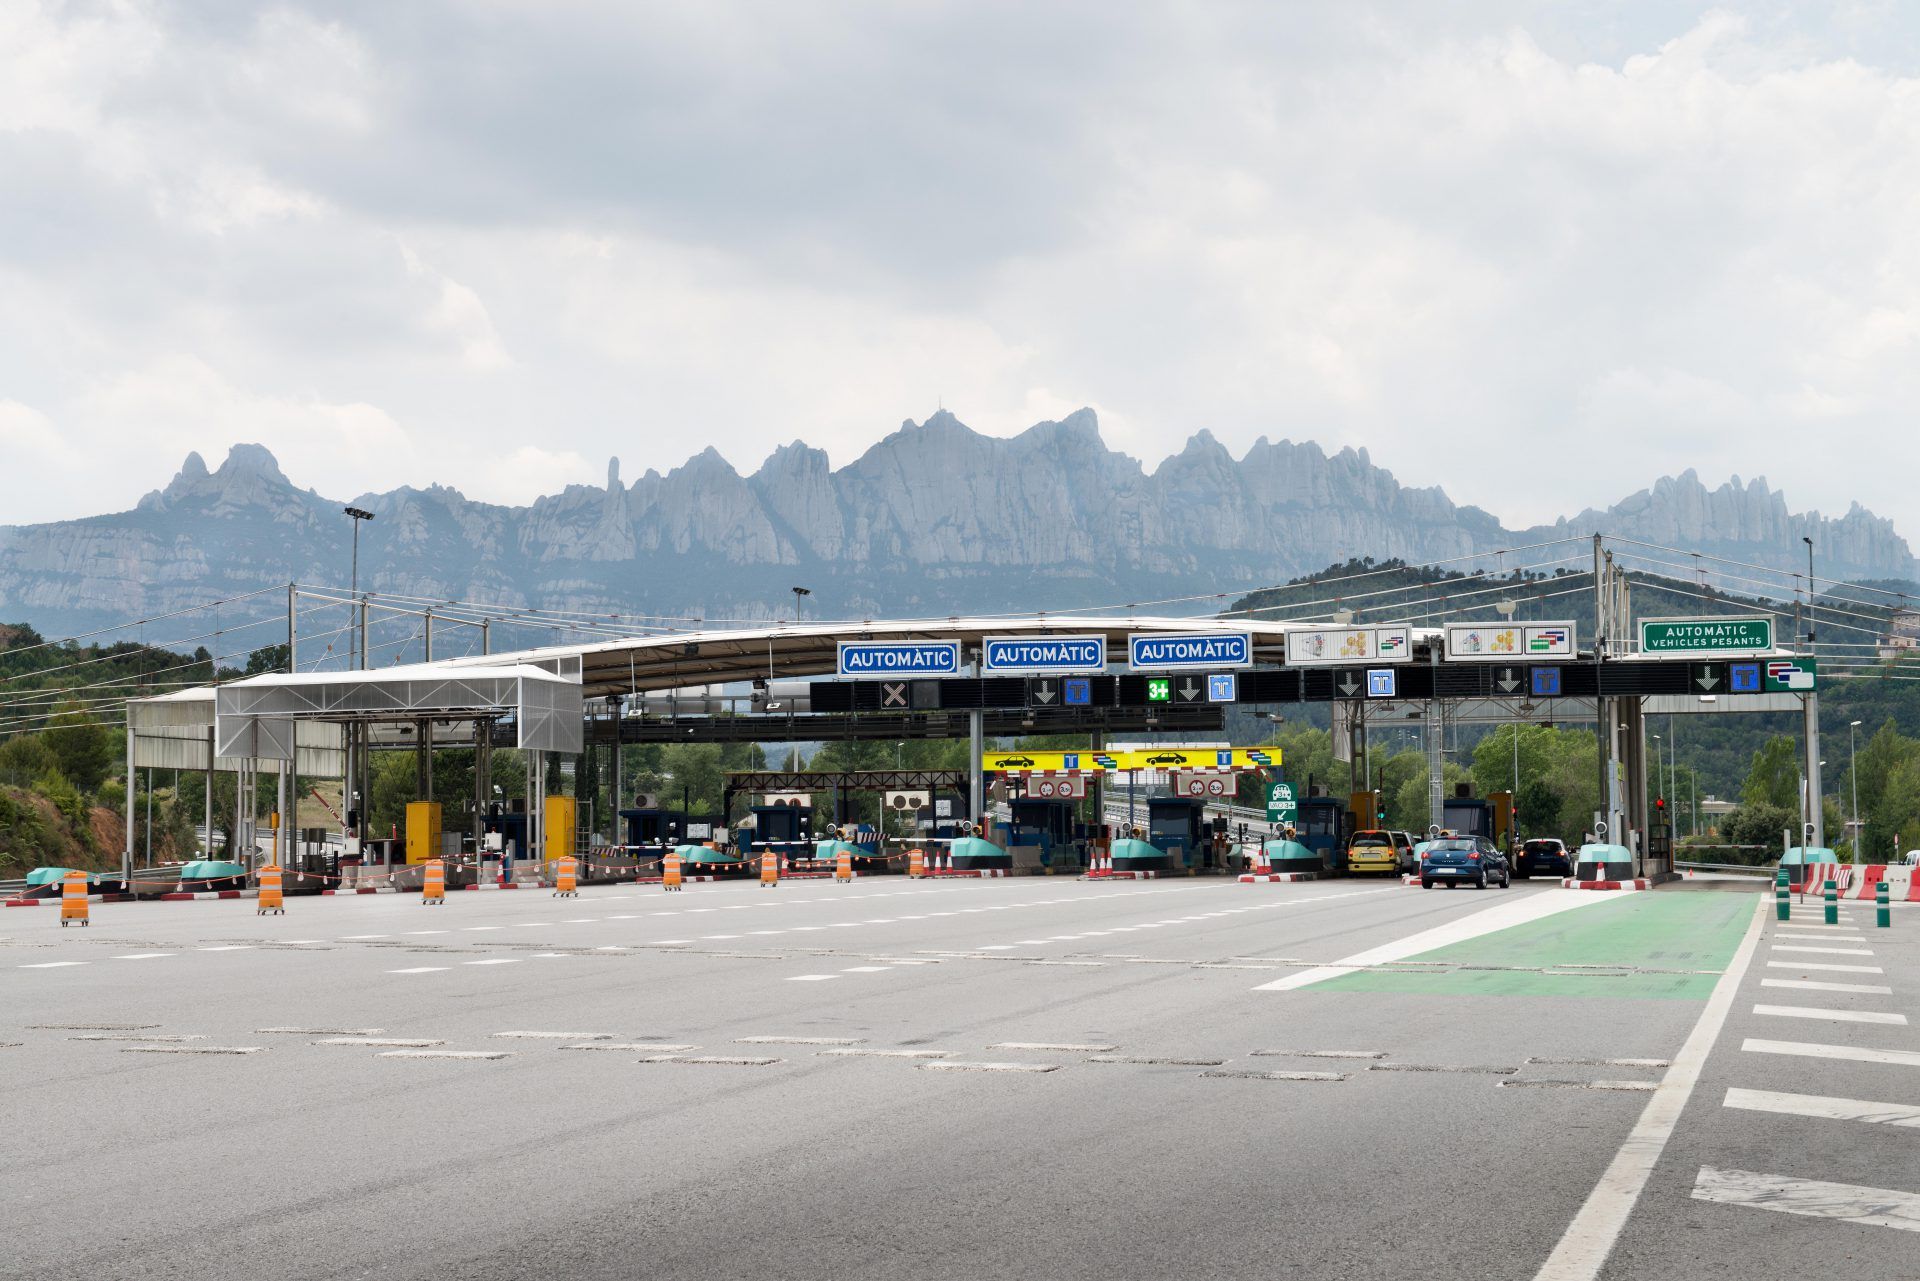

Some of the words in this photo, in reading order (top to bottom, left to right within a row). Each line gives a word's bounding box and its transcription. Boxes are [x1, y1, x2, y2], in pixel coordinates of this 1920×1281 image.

[1666, 625, 1747, 637] AUTOMÀTIC
[1140, 640, 1241, 659] AUTOMÀTIC
[1652, 638, 1707, 647] VEHICLES
[1711, 637, 1762, 646] PESANTS
[849, 649, 949, 667] AUTOMÀTIC
[994, 643, 1095, 662] AUTOMÀTIC
[1149, 683, 1169, 698] 3+
